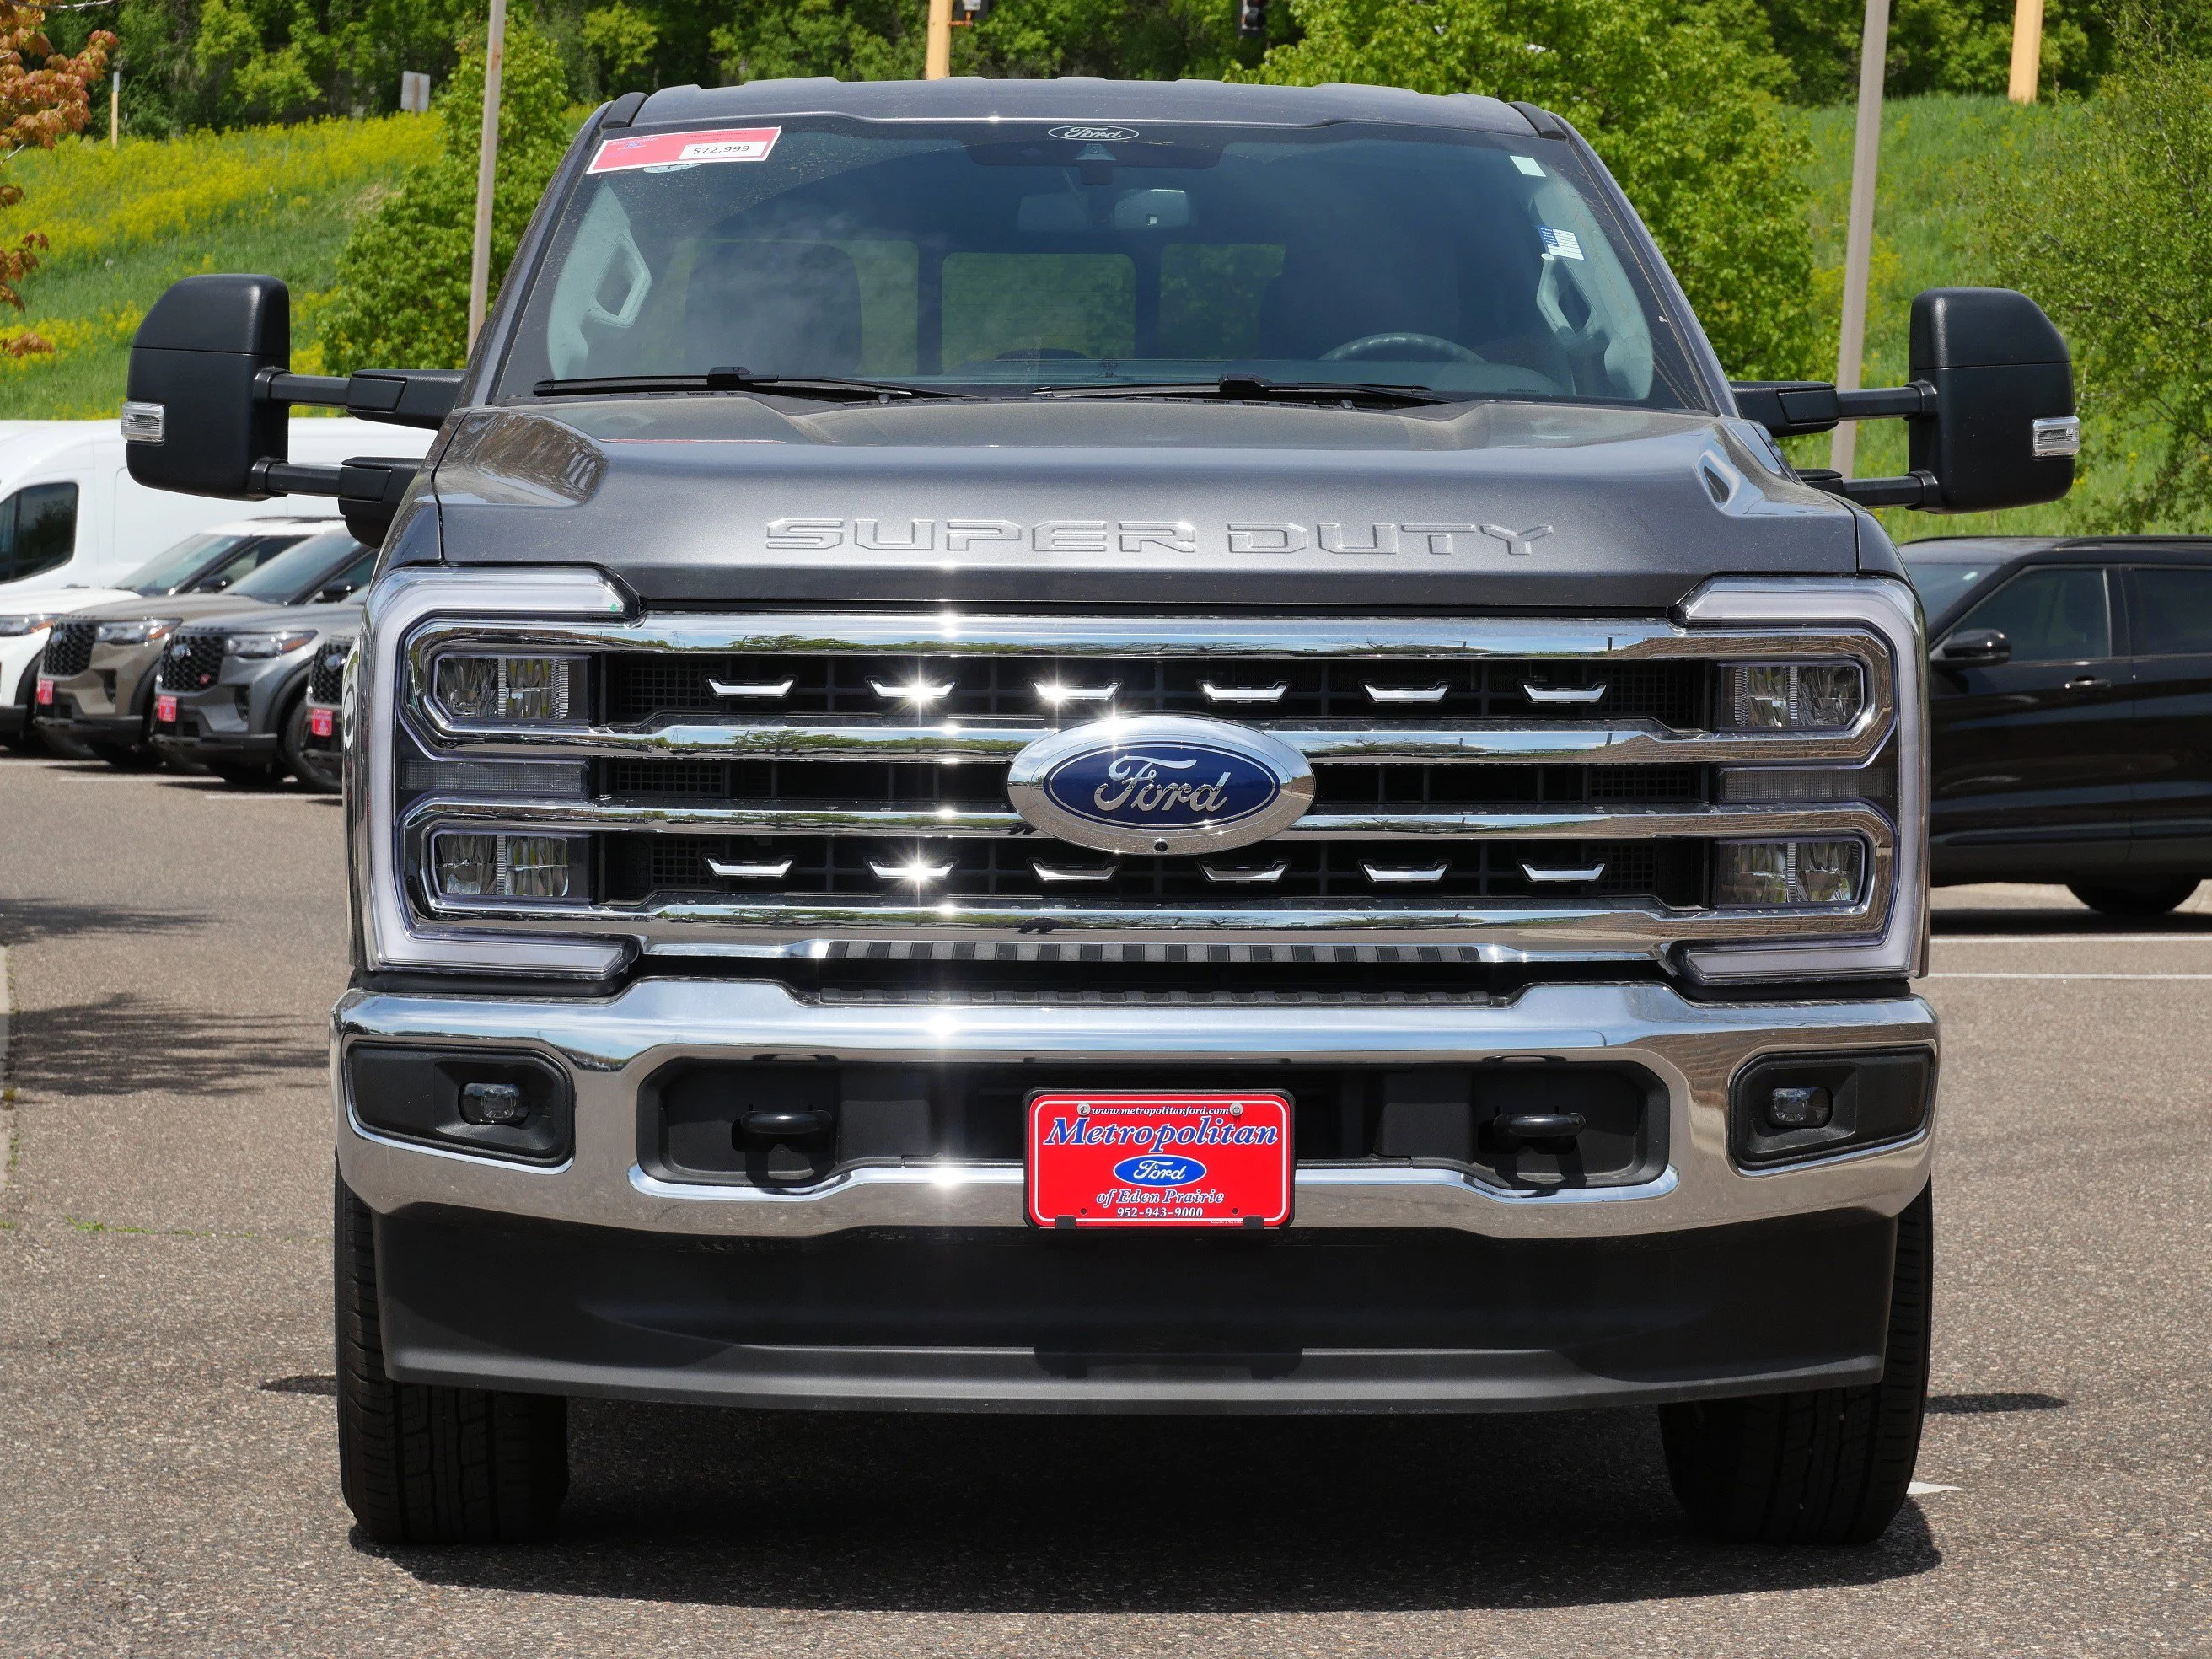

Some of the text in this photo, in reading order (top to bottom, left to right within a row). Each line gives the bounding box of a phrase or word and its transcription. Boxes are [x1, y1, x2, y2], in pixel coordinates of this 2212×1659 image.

[1064, 126, 1122, 139] Ford
[691, 145, 750, 155] $72,999
[765, 518, 1554, 555] SUPER DUTY
[1093, 754, 1232, 813] Ford
[1092, 1106, 1229, 1117] www.metropolitanford.com
[1043, 1115, 1279, 1154] Metropolitan
[1133, 1159, 1188, 1180] Ford
[1096, 1188, 1225, 1208] of Eden Prairie
[1117, 1207, 1204, 1217] 952-943-9000
